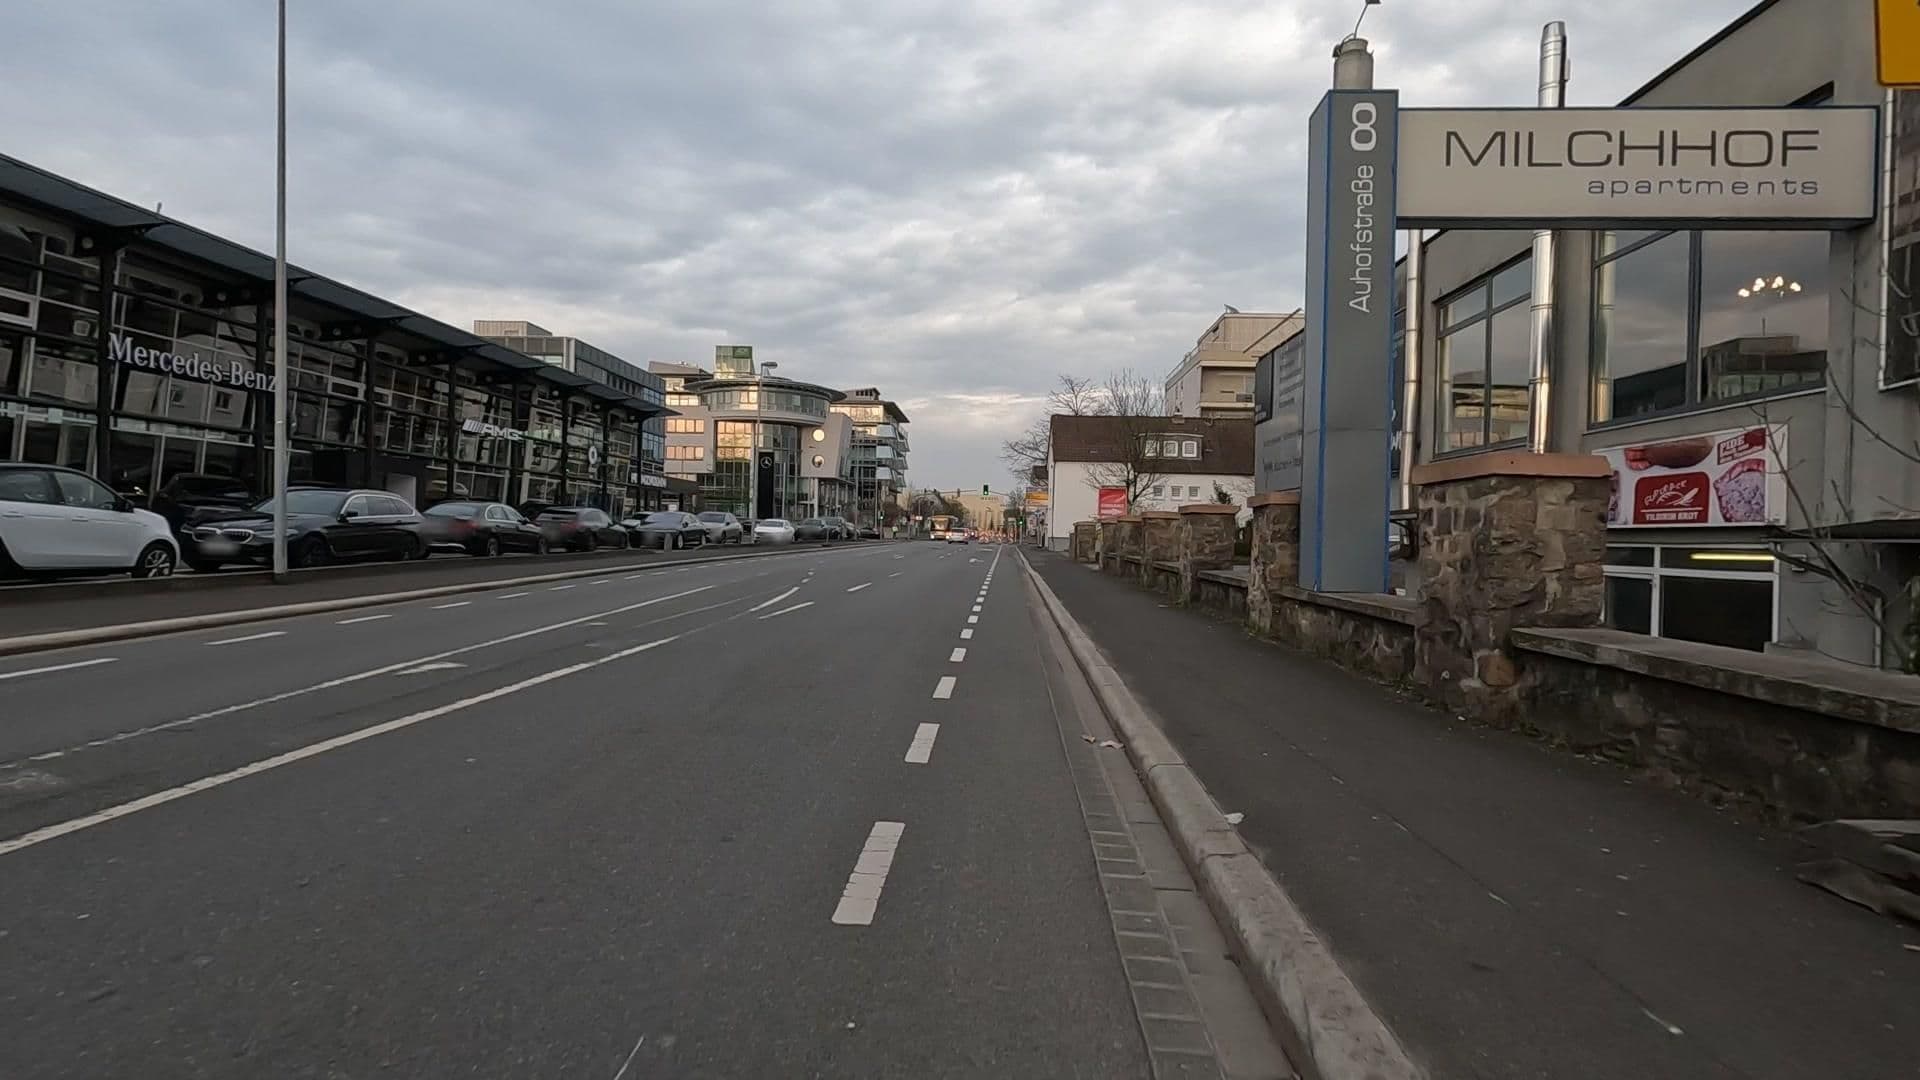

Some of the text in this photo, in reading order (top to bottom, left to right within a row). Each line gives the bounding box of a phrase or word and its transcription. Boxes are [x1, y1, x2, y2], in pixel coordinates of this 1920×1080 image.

[1445, 130, 1820, 168] MILCHHOF
[1588, 176, 1819, 197] apartments
[1348, 101, 1377, 314] Auhofstraße 8
[107, 332, 278, 393] Mercedes-Benz
[481, 424, 524, 440] AMG
